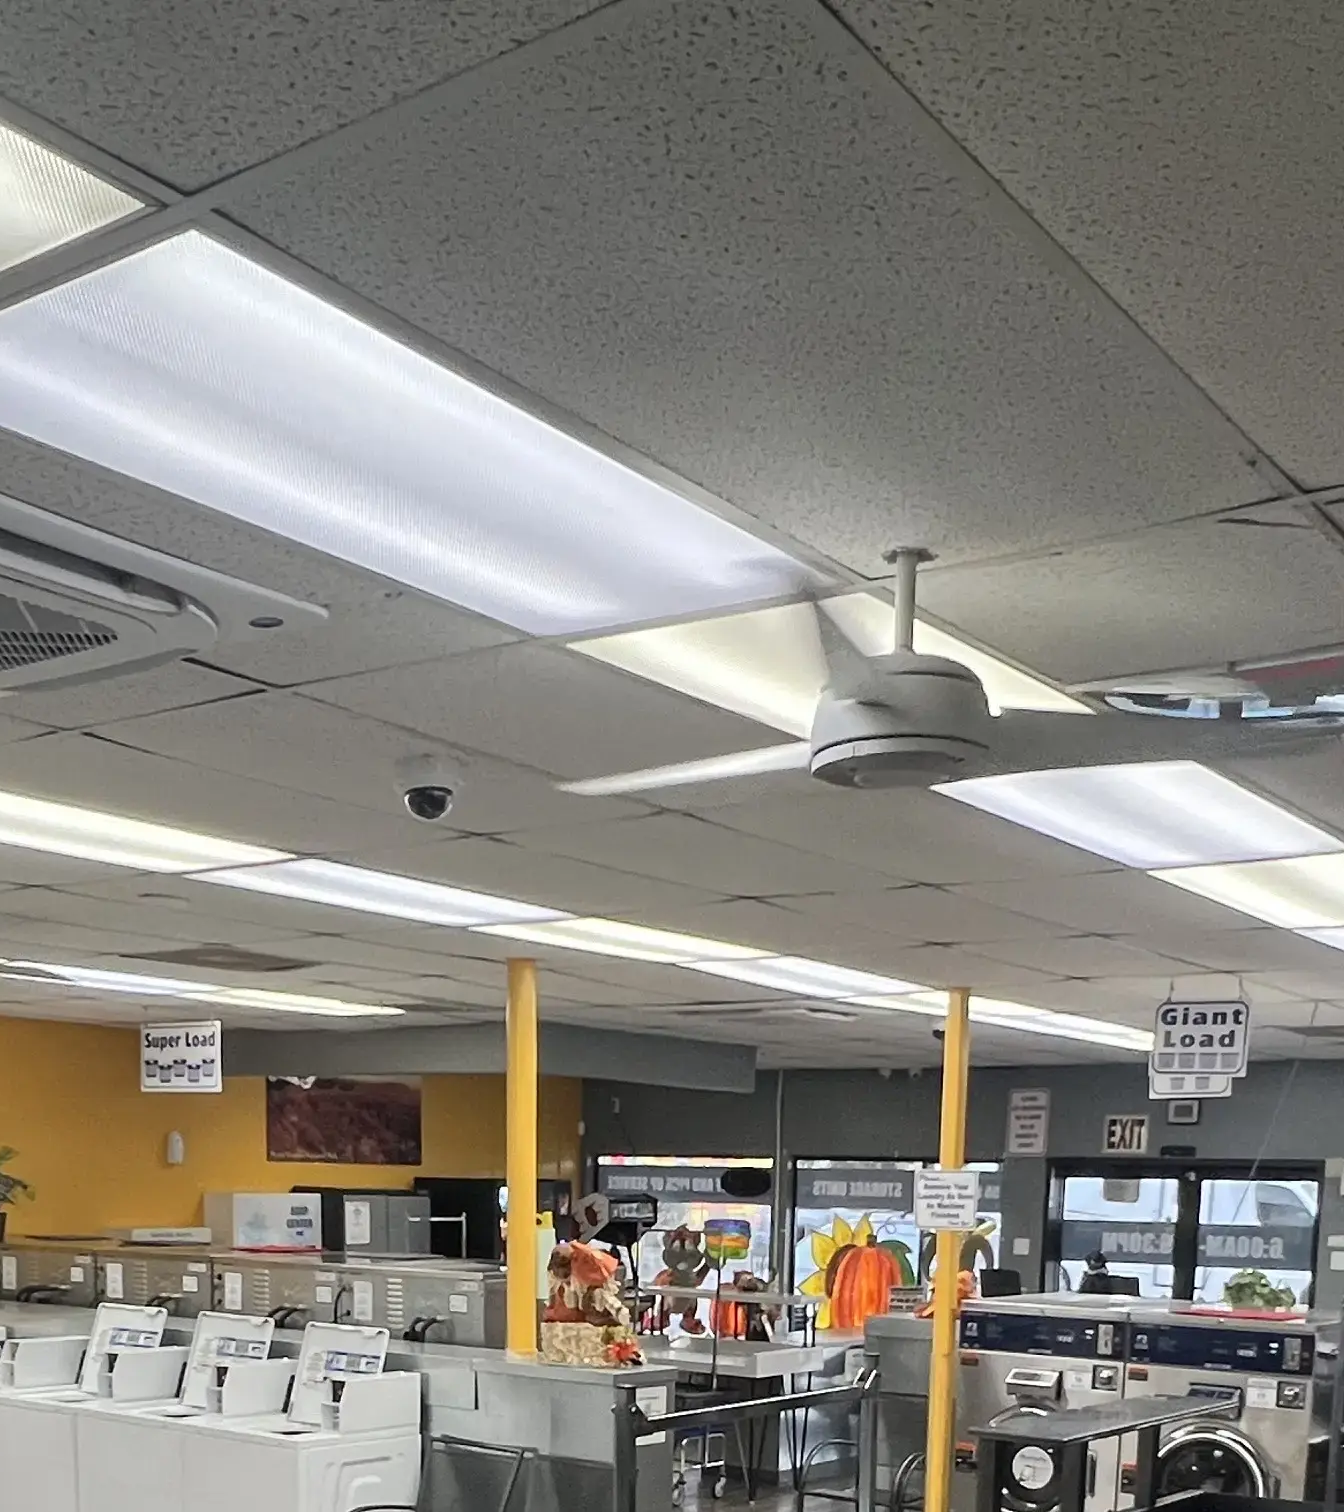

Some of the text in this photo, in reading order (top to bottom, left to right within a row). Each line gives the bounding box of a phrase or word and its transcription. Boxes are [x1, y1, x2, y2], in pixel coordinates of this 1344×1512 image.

[1161, 1007, 1244, 1025] Giant
[144, 1031, 215, 1052] Super Load
[1163, 1030, 1236, 1048] Load
[1107, 1118, 1145, 1150] EXIT
